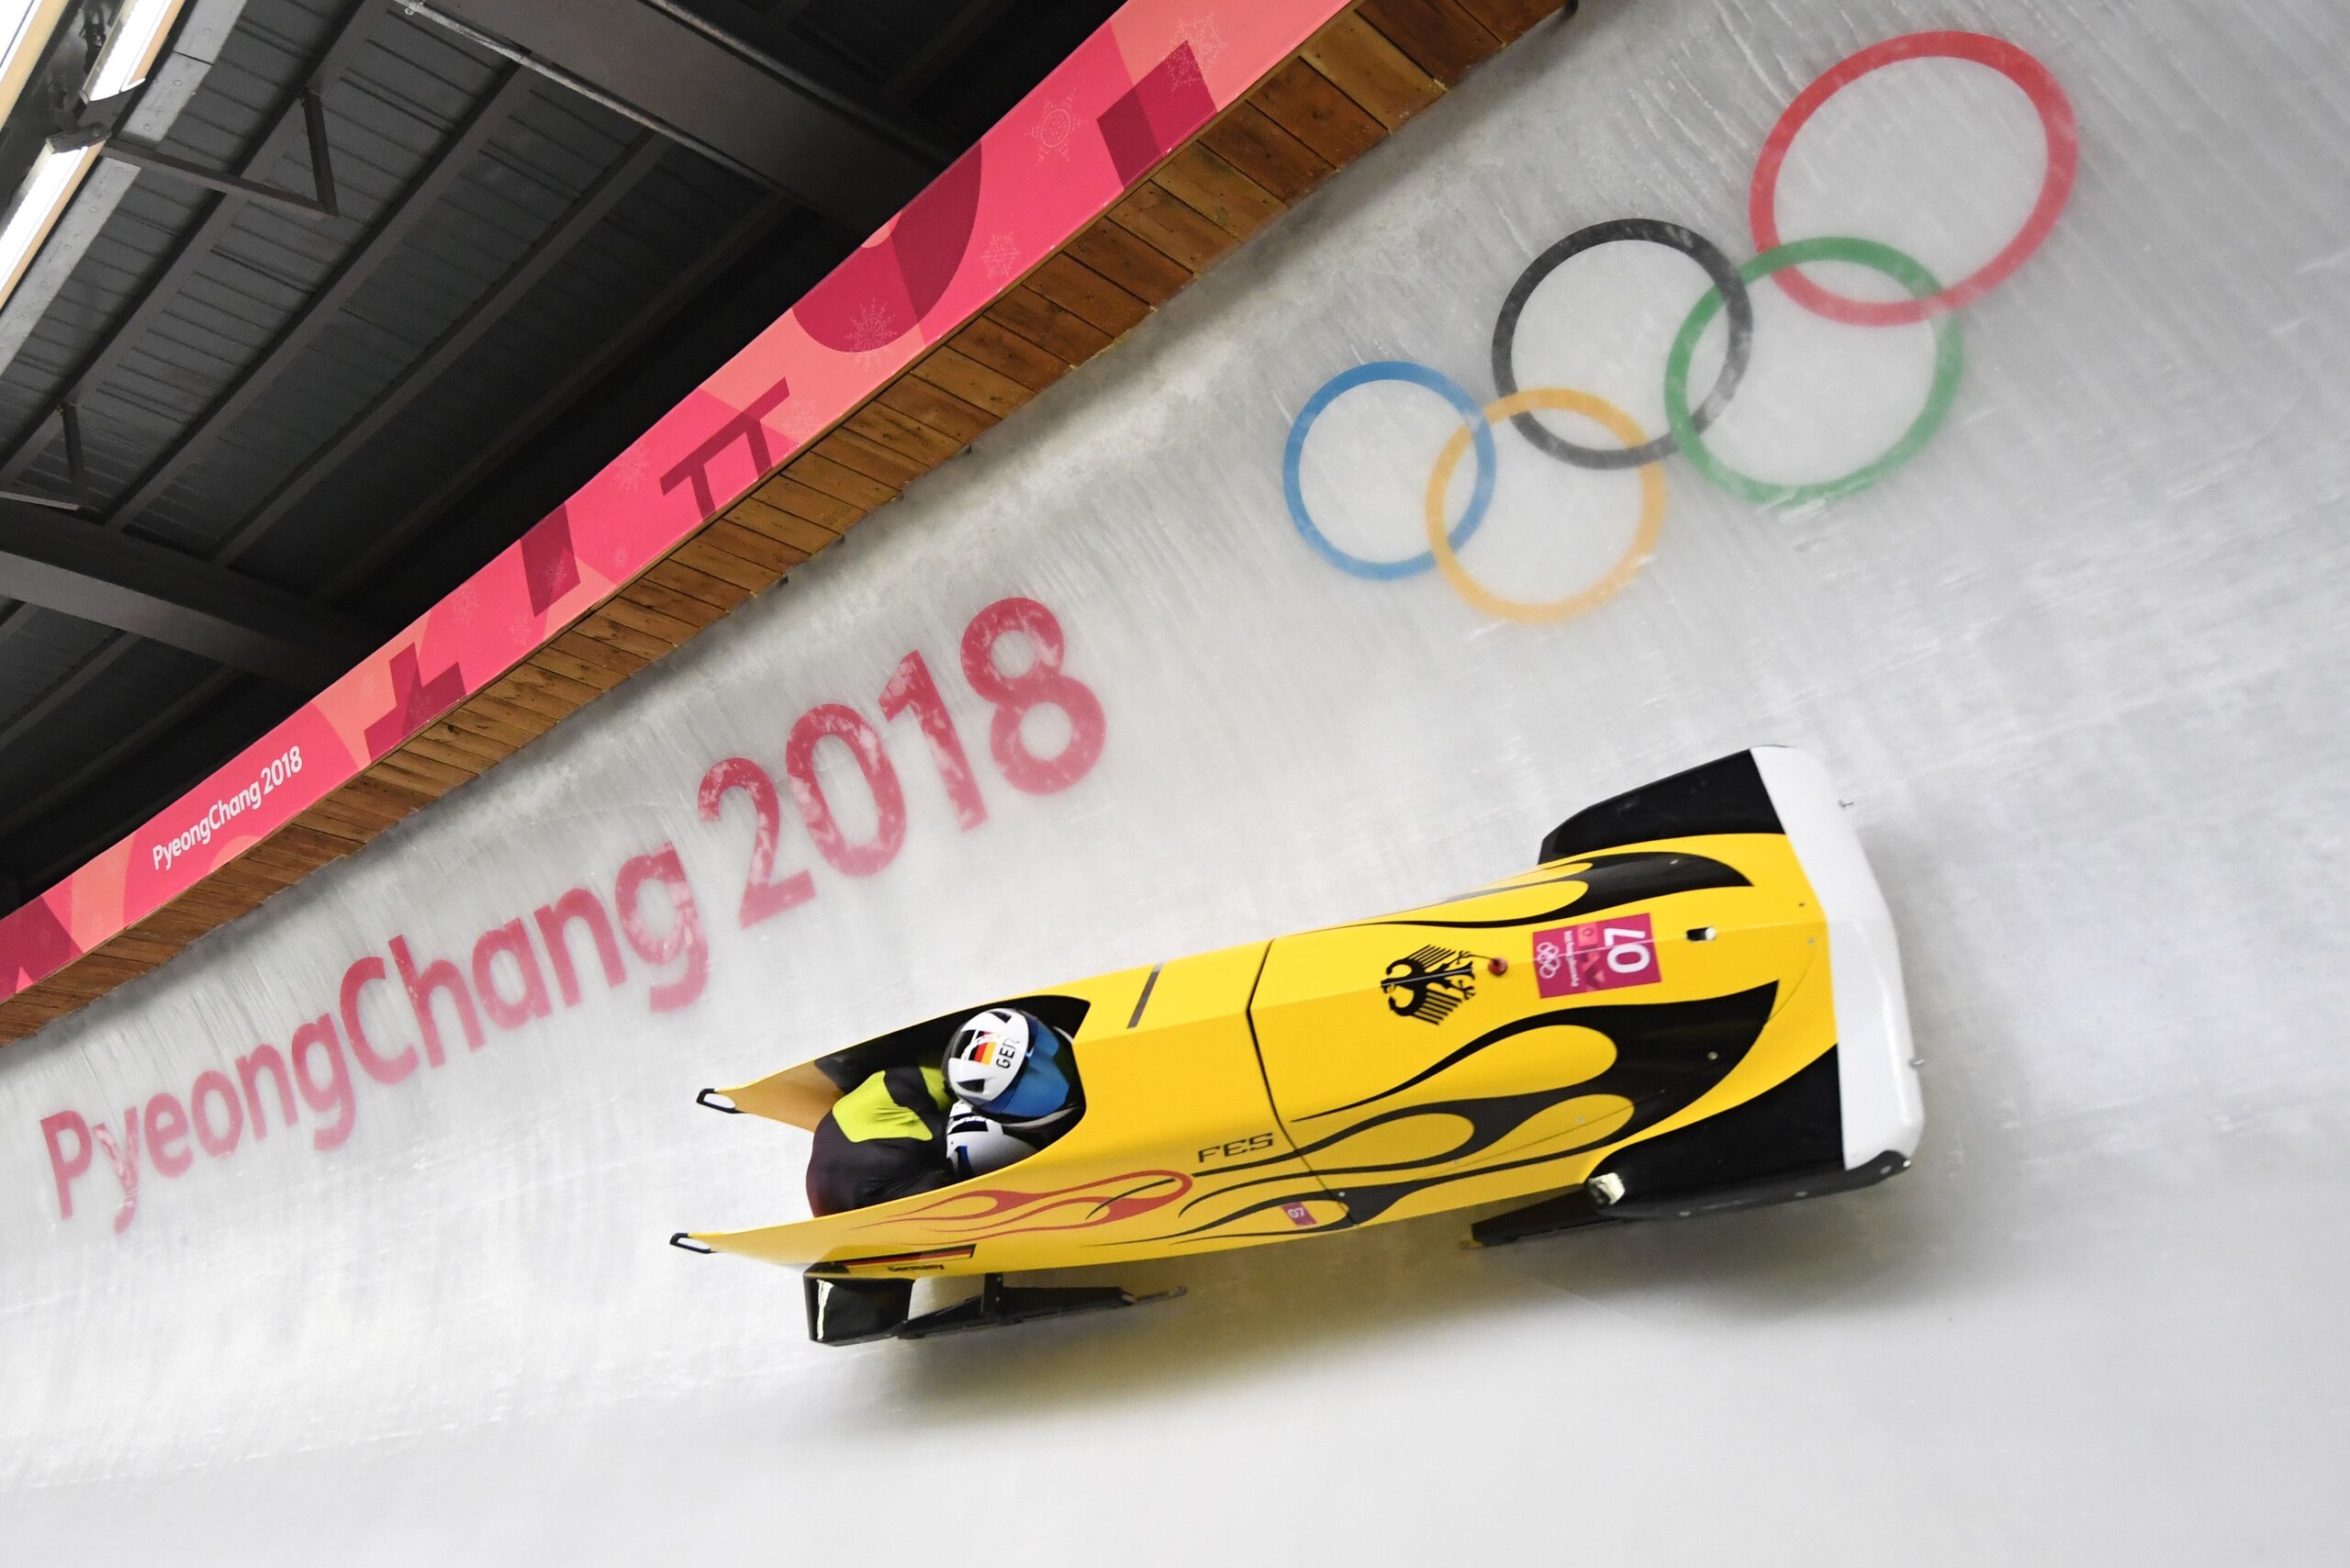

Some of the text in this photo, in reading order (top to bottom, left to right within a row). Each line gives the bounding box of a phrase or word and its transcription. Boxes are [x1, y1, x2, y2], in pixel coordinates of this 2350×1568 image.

[152, 745, 303, 870] PyeongChang 2018
[39, 597, 1107, 1234] PyeongChang 2018
[1604, 927, 1651, 973] 07
[1198, 1132, 1273, 1163] FES
